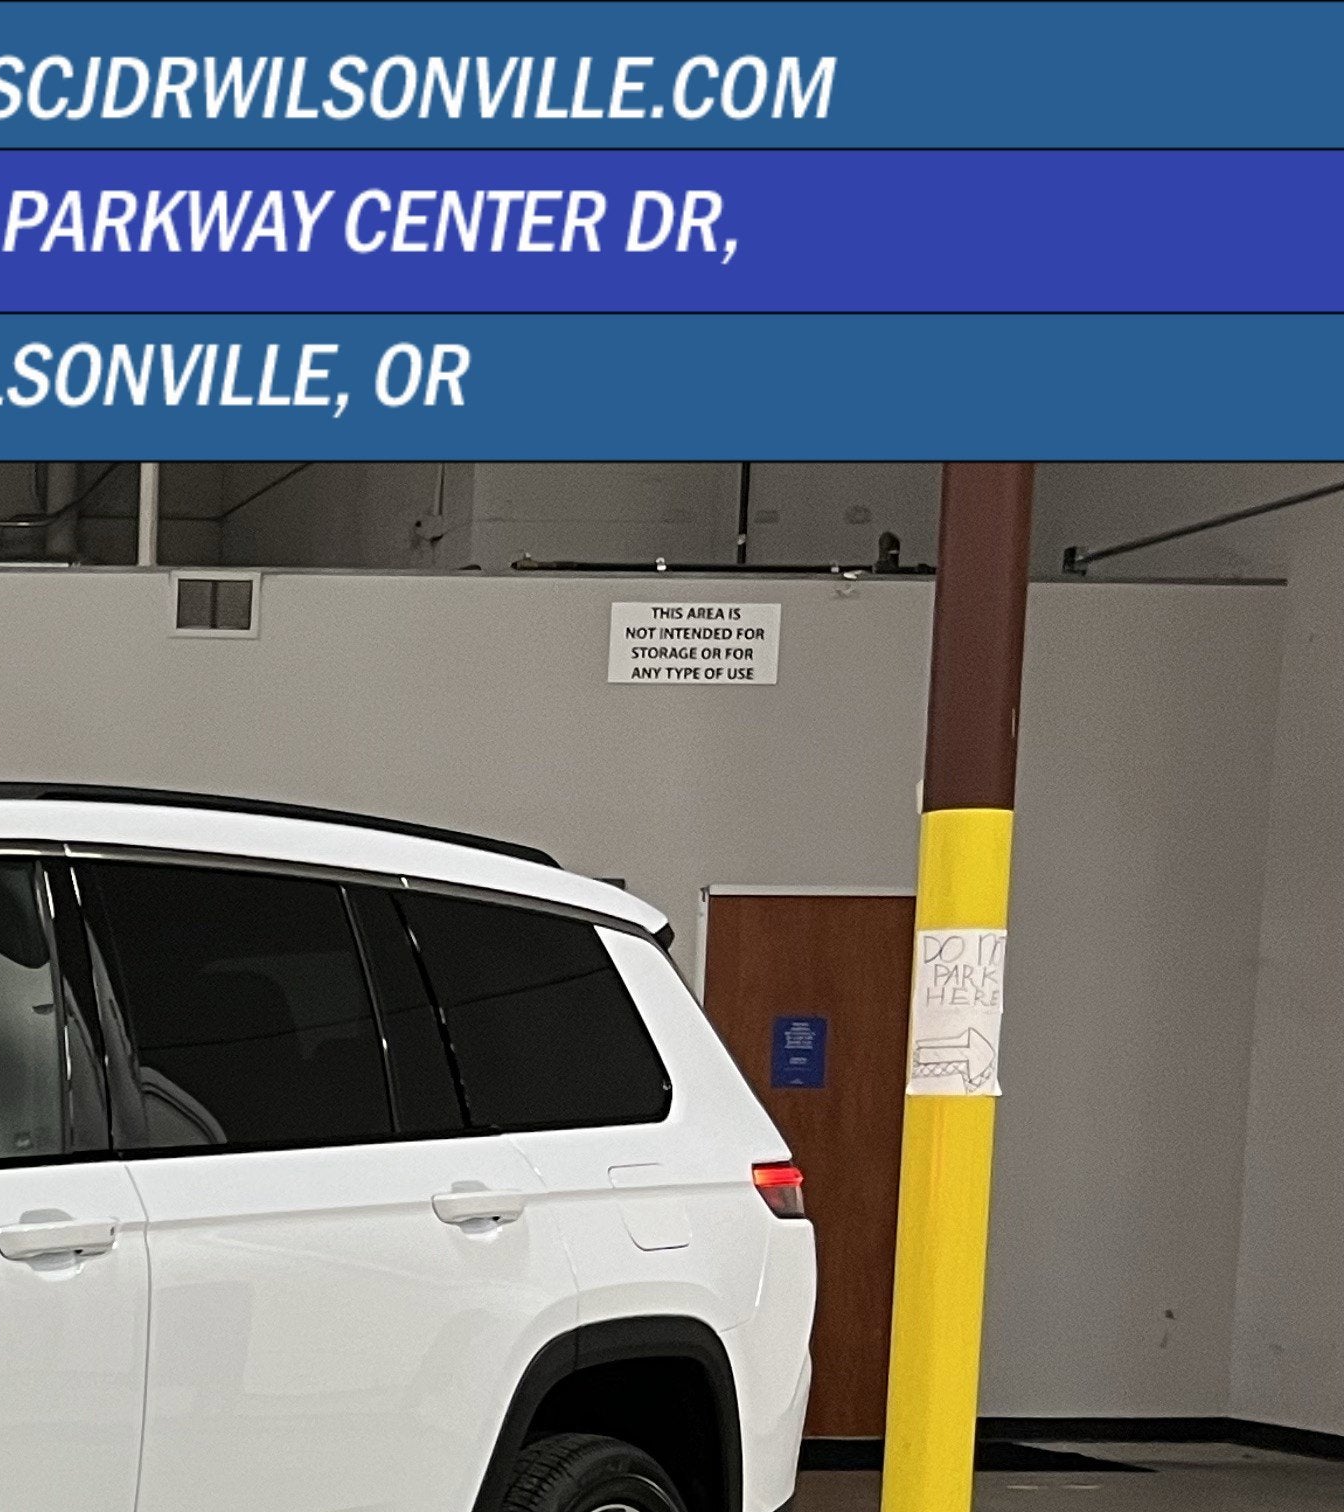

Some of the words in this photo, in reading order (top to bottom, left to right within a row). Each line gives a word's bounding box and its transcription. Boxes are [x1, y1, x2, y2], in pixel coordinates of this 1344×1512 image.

[652, 607, 683, 620] THIS
[687, 608, 724, 620] AREA
[729, 608, 741, 620] IS
[626, 627, 656, 640] NOT
[660, 627, 732, 640] INTENDED
[736, 628, 764, 640] FOR
[631, 647, 697, 659] STORAGE
[701, 648, 721, 660] OR
[725, 648, 753, 660] FOR
[631, 667, 661, 679] ANY
[665, 667, 700, 680] TYPE
[704, 667, 723, 679] OF
[727, 668, 754, 680] USE
[923, 935, 965, 964] DO
[934, 963, 999, 988] PARK
[926, 987, 999, 1006] HERE
